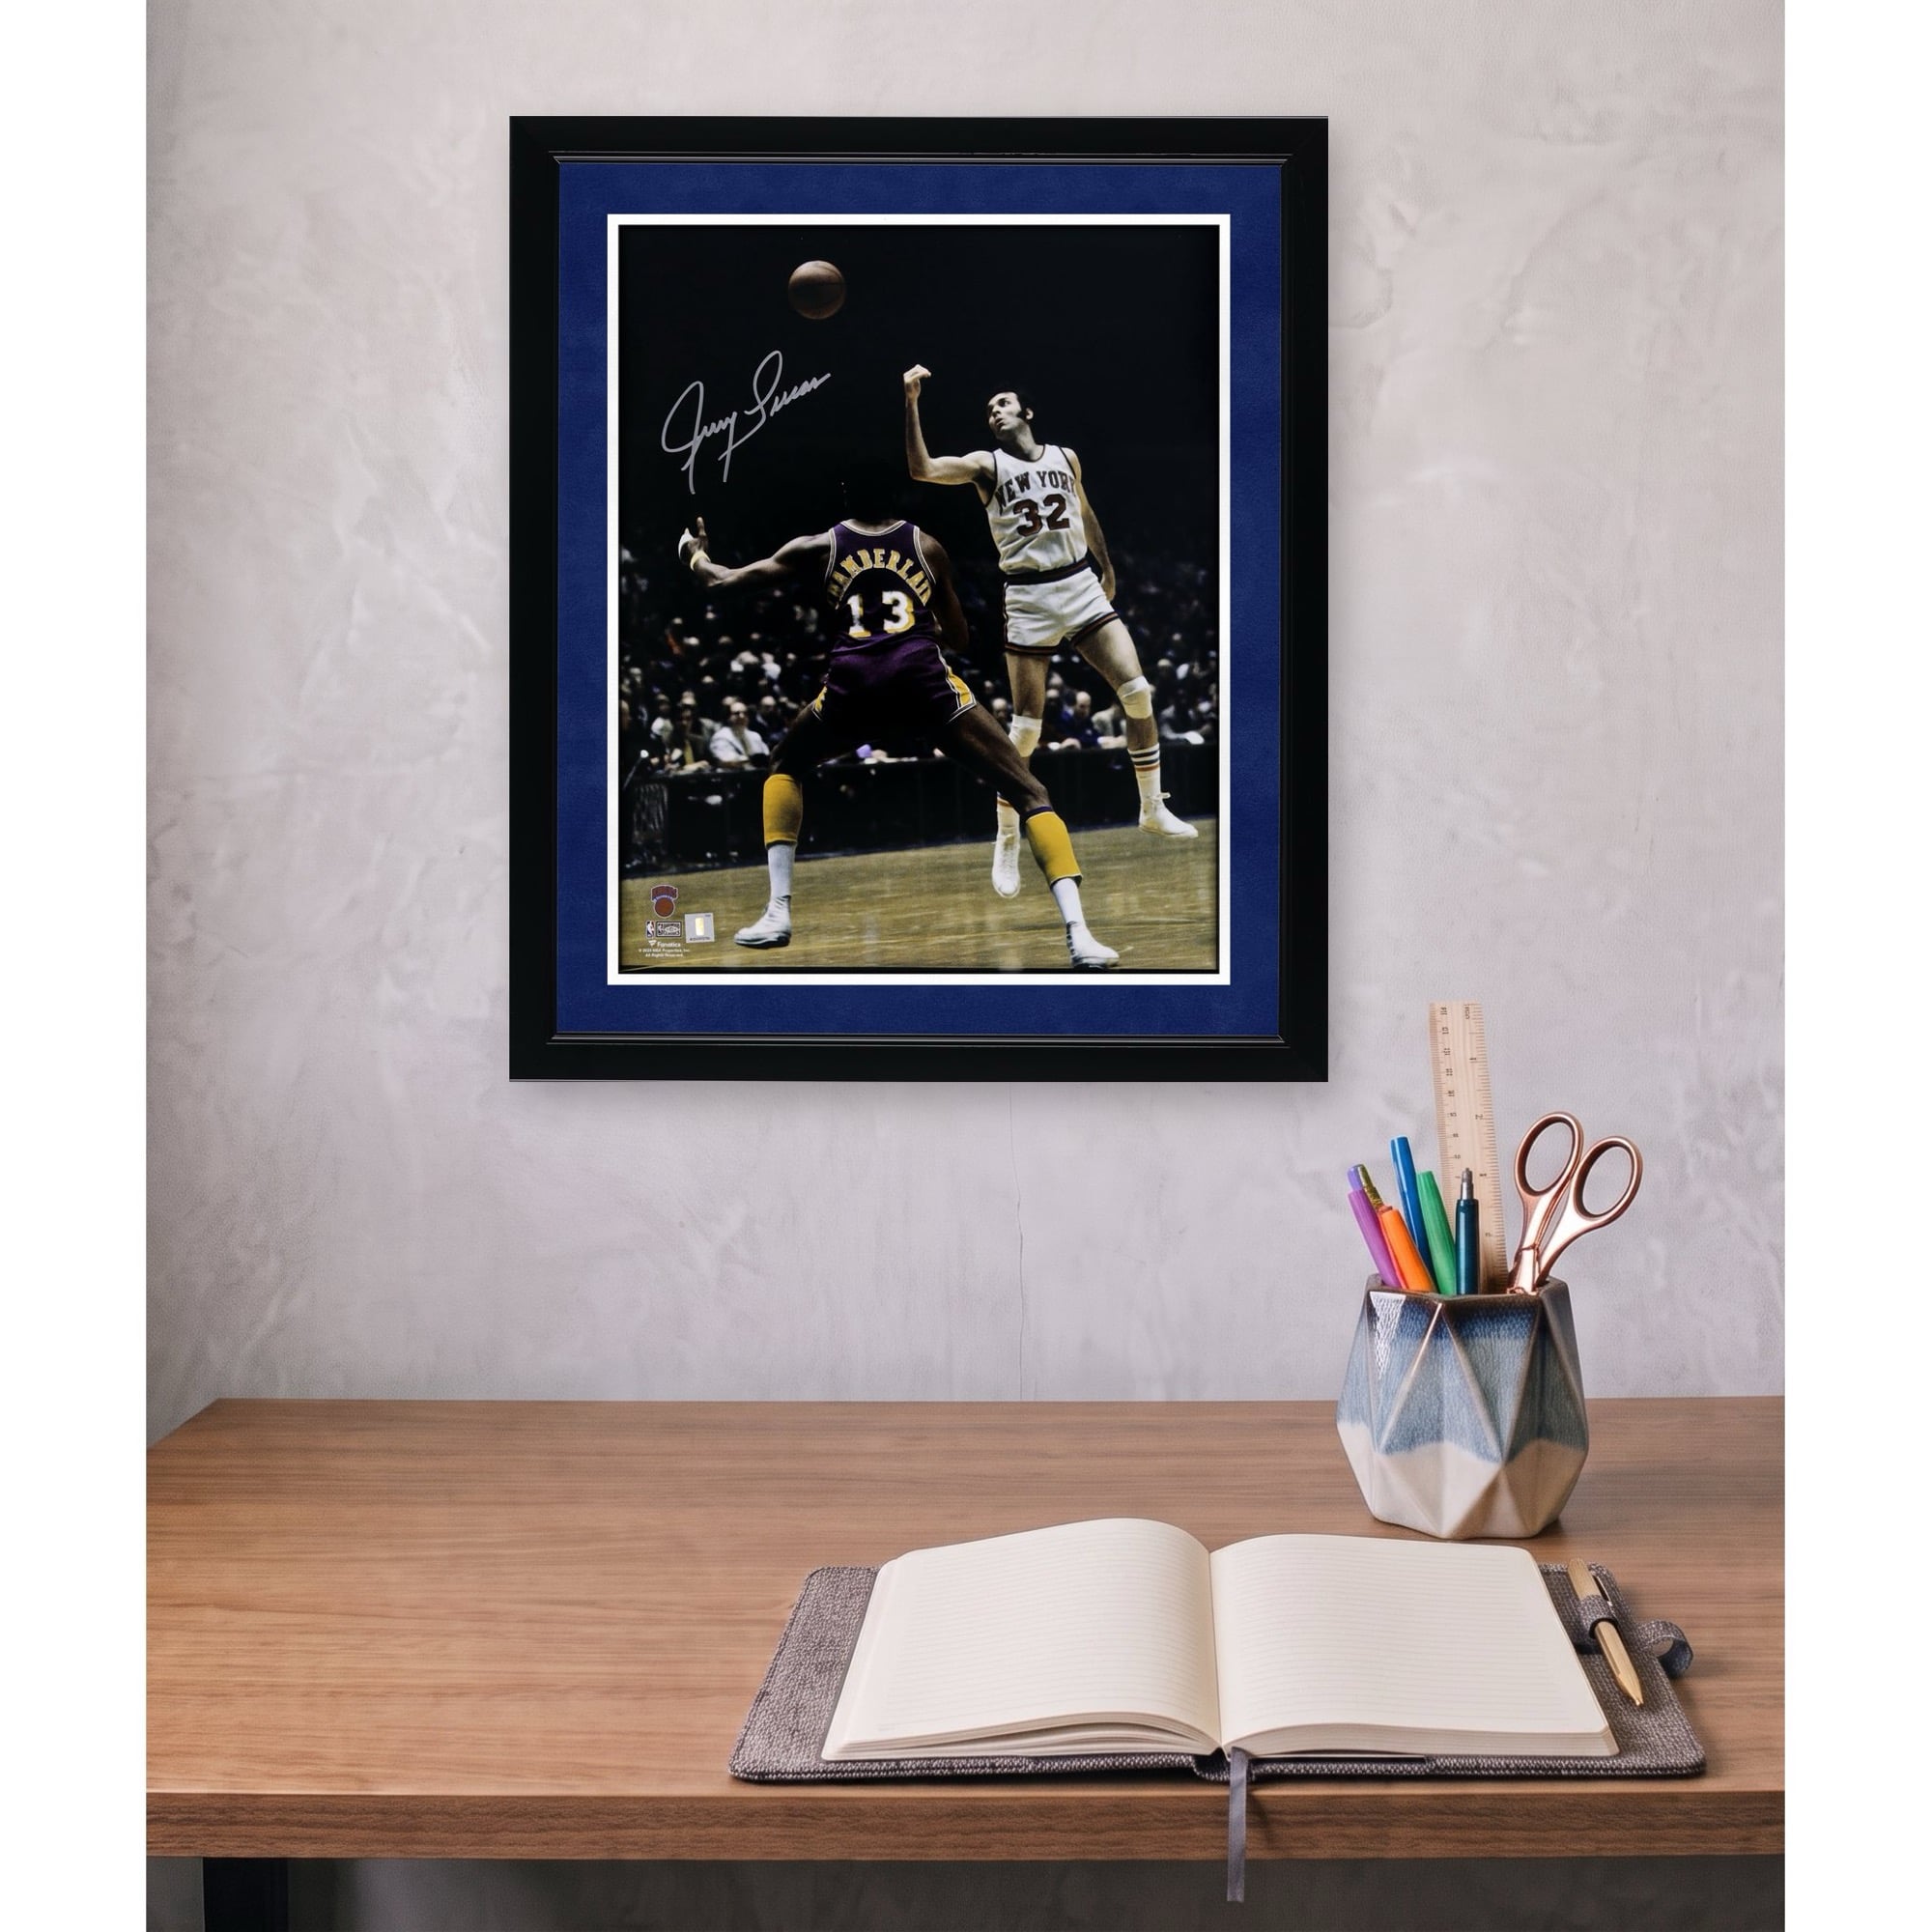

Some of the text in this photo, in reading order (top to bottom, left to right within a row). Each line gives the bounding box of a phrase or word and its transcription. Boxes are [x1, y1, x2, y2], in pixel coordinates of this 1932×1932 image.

[994, 471, 1031, 516] NEW
[1013, 494, 1070, 537] 32
[846, 590, 916, 639] 13
